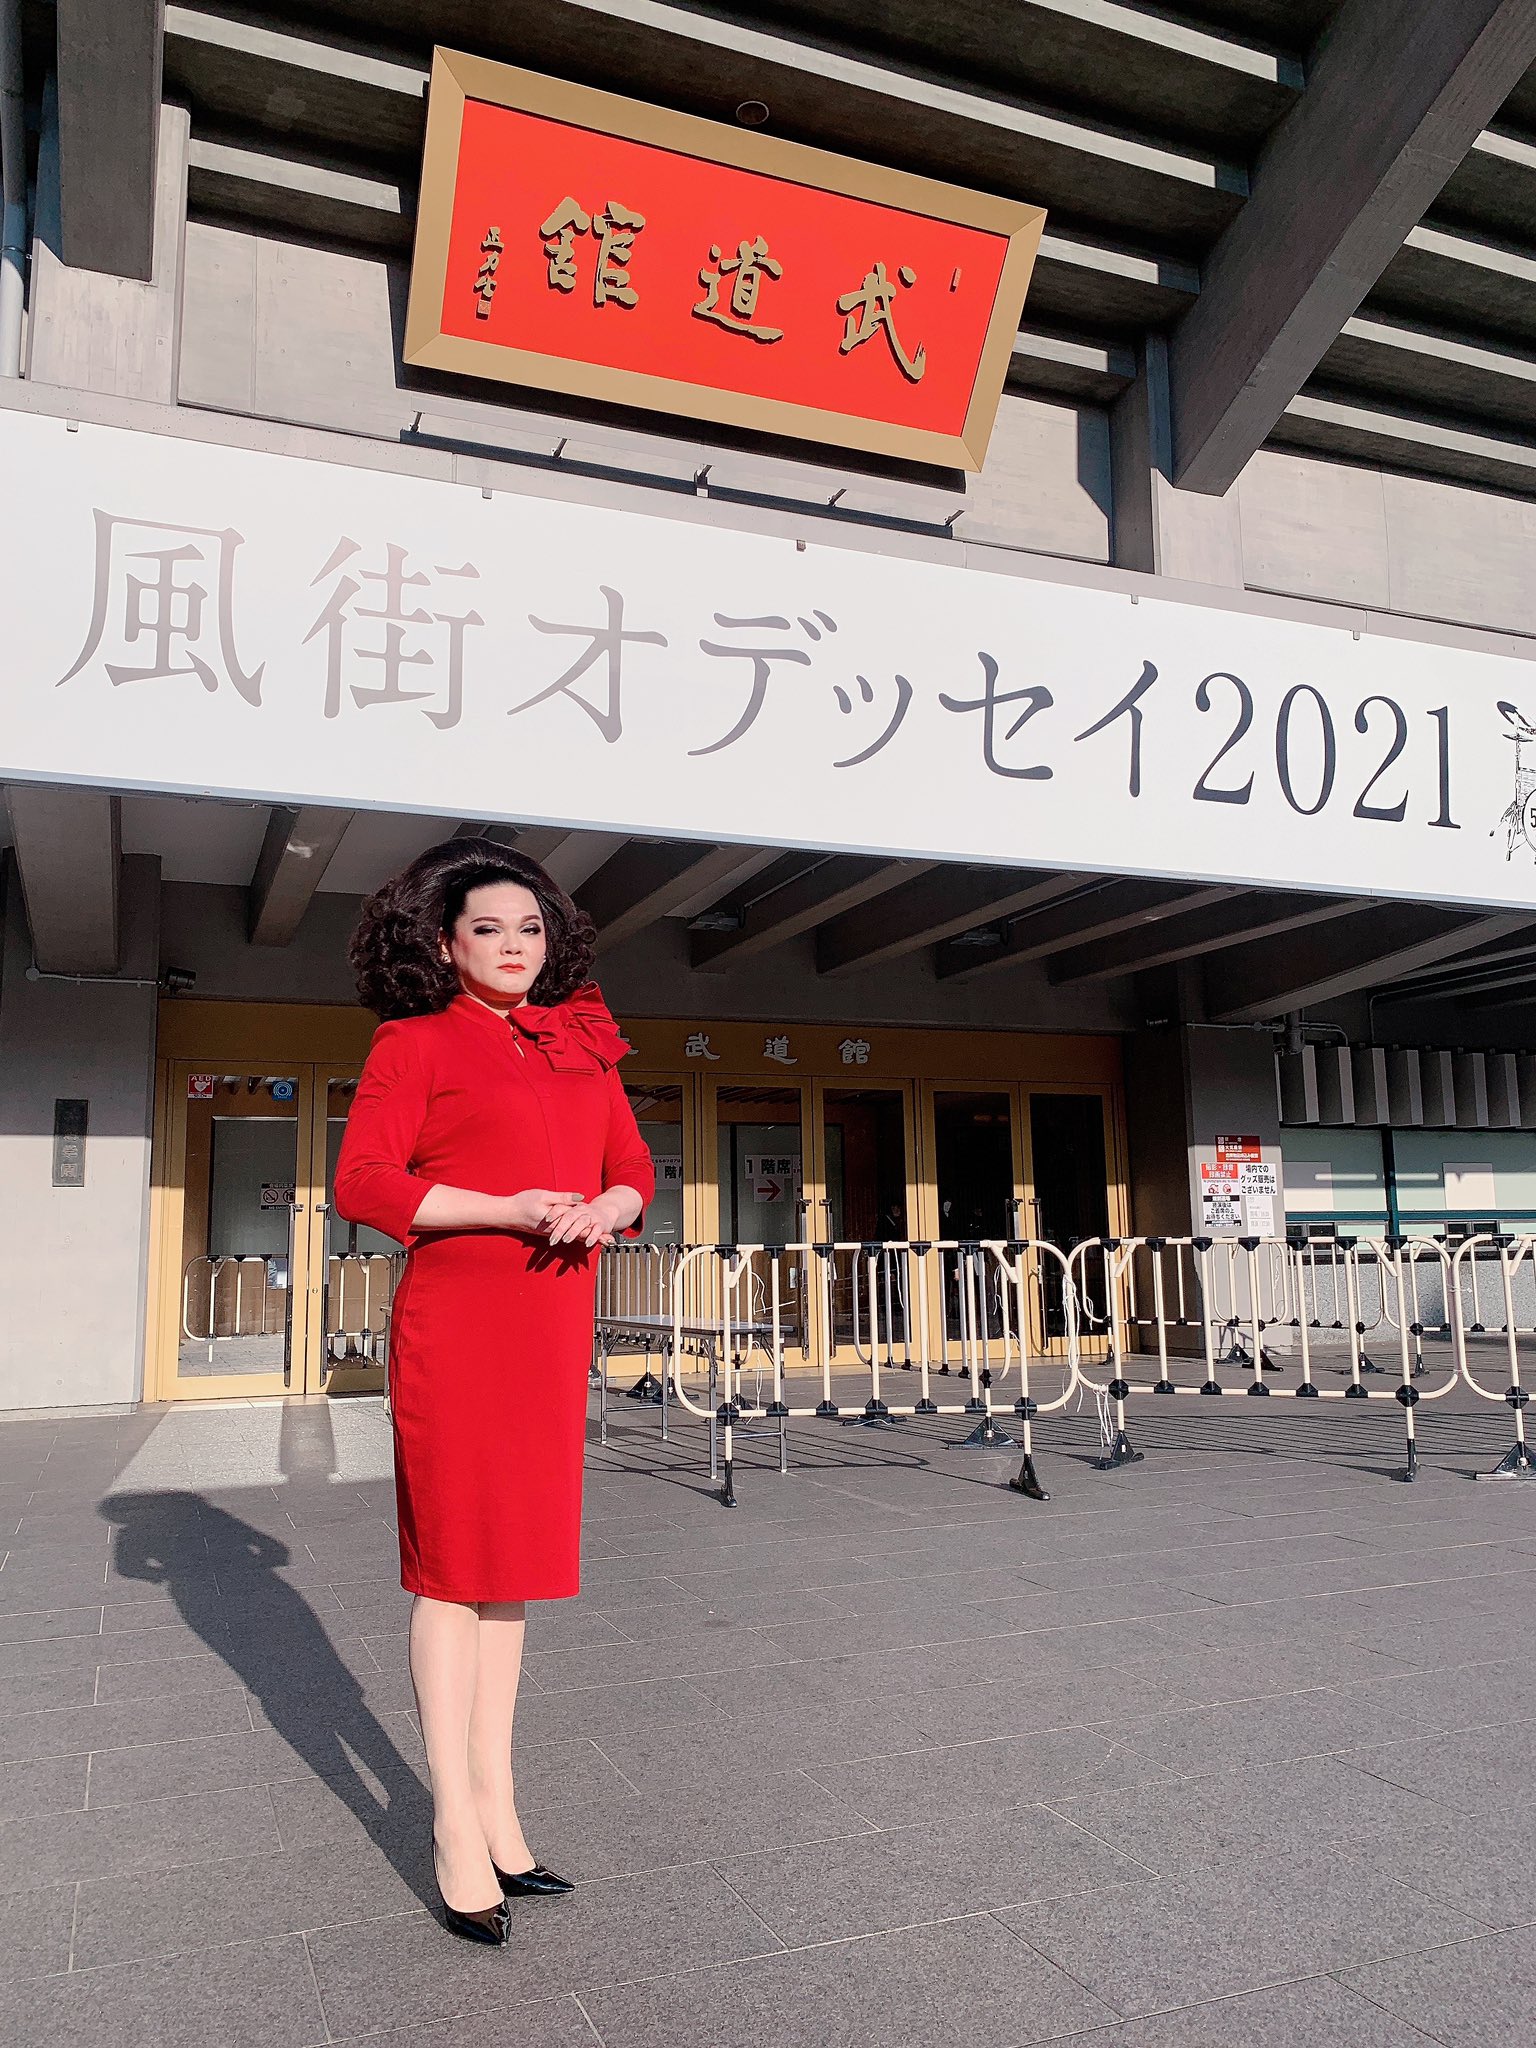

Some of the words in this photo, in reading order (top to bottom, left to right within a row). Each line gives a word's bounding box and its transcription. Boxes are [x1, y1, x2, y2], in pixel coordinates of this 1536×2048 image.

[55, 507, 1461, 829] 風街オデッセイ2021
[1241, 1186, 1276, 1194] ございません
